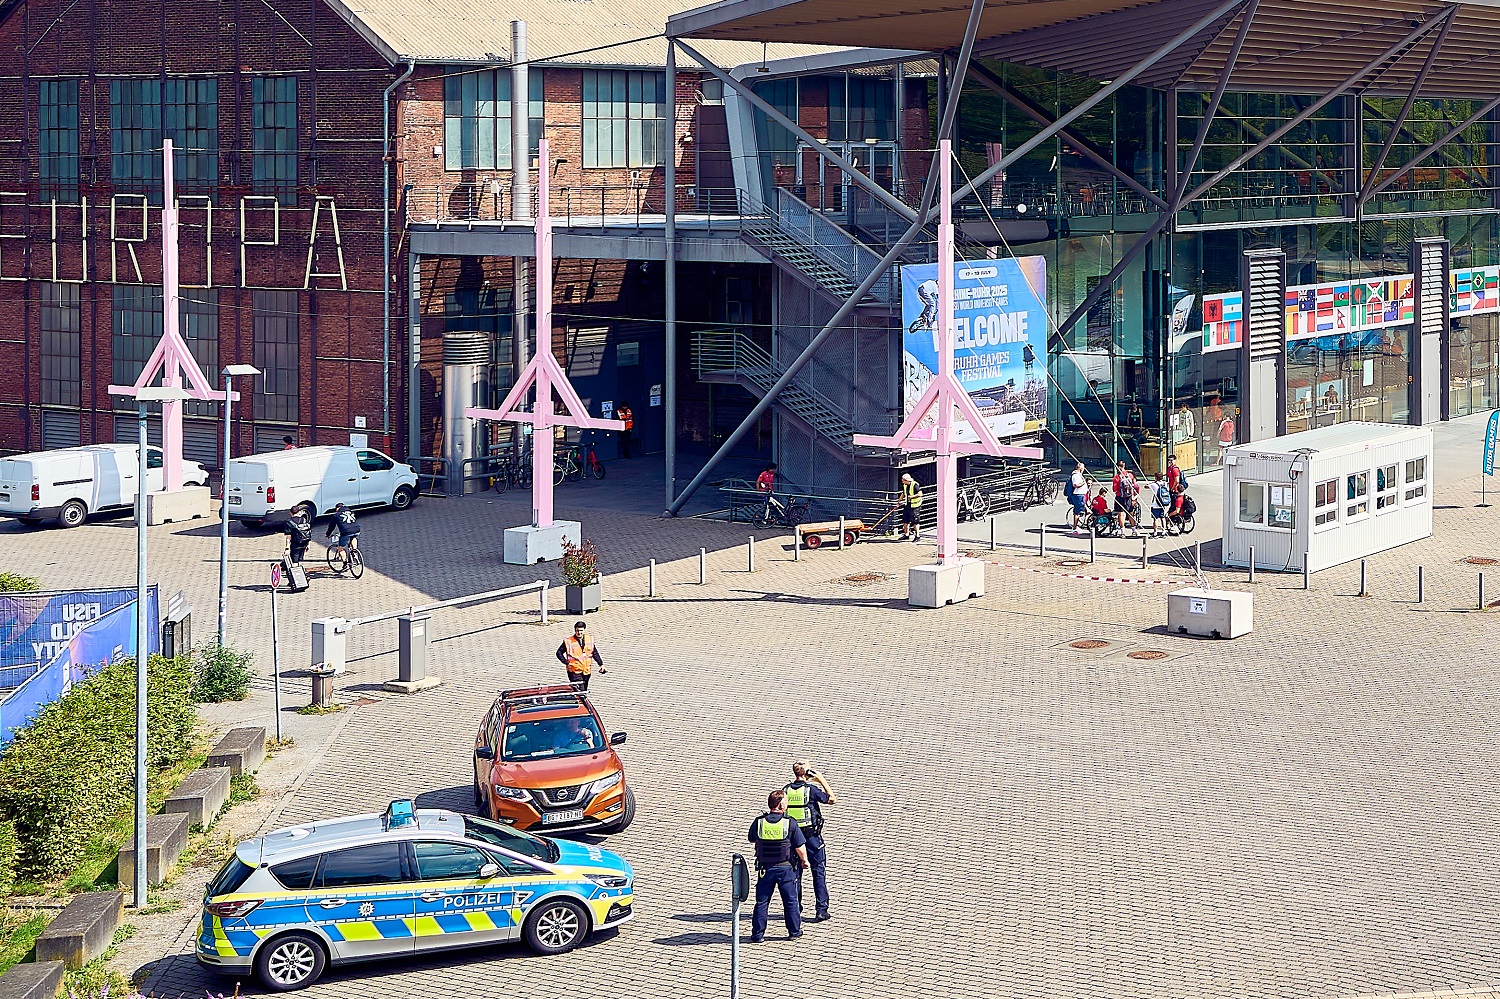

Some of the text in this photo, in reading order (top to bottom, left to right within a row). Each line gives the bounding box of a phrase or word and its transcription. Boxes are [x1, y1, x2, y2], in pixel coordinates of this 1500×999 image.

[991, 285, 1008, 297] 2025
[932, 311, 1029, 352] ELCOME
[980, 351, 1010, 367] GAMES
[961, 365, 1003, 382] FESTIVAL
[1486, 418, 1497, 473] RUHR GAMES
[444, 893, 501, 909] POLIZEI
